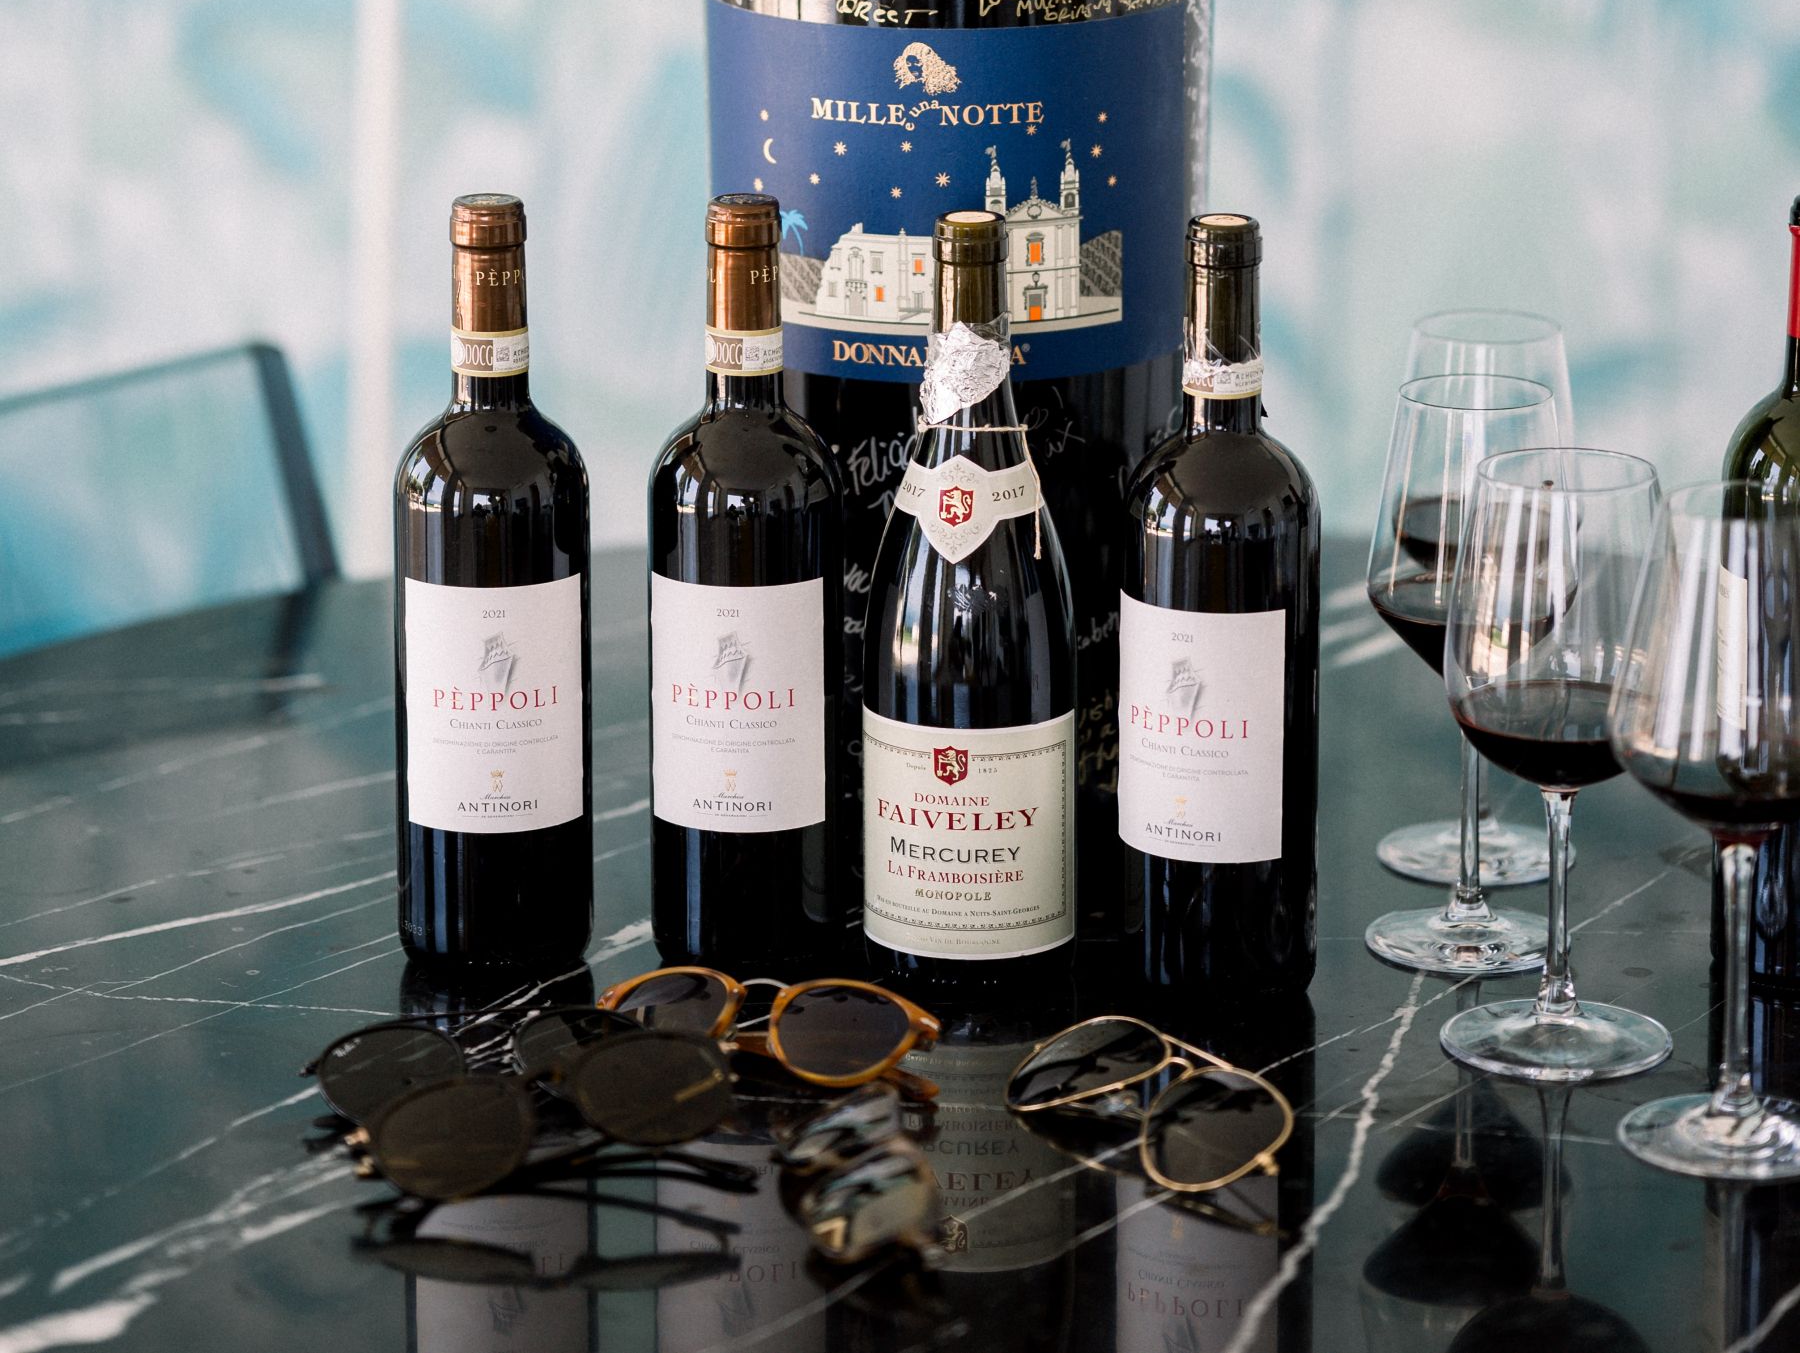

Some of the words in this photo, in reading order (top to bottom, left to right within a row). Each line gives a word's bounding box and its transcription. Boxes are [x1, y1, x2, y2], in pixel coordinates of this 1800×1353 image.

[811, 97, 906, 126] MILLE
[909, 99, 940, 118] una
[939, 101, 1045, 127] NOTTE
[465, 344, 493, 366] DOCG
[716, 342, 742, 365] DOCG
[902, 480, 926, 498] 2017
[991, 485, 1026, 502] 2017
[482, 609, 506, 619] 2021
[716, 608, 740, 618] 2021
[1171, 632, 1194, 643] 2021
[433, 685, 559, 712] PÈPPOLI
[672, 683, 796, 711] PÈPPOLI
[1131, 705, 1249, 739] PÈPPOLI
[457, 799, 538, 813] ANTINORI
[692, 798, 772, 812] ANTINORI
[914, 792, 990, 807] DOMAINE
[877, 798, 1039, 832] FAIVELEY
[1145, 822, 1222, 842] ANTINORI
[890, 836, 1020, 864] MERCUREY
[908, 865, 1024, 884] FRAMBOISIÈRE
[915, 887, 992, 902] MONOPOLE
